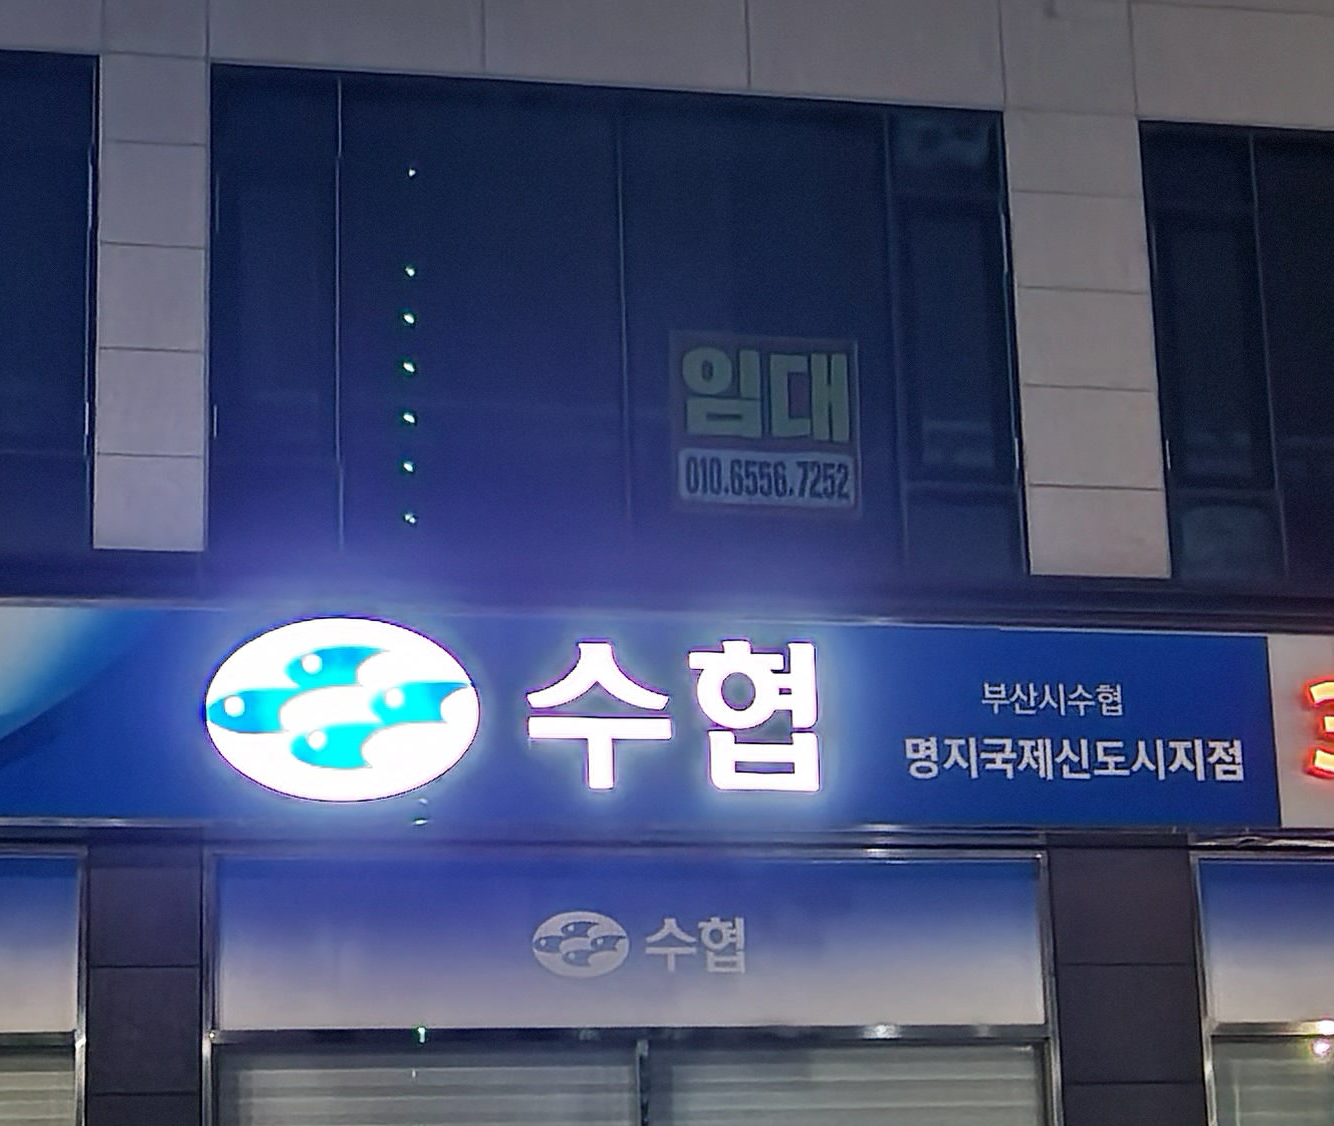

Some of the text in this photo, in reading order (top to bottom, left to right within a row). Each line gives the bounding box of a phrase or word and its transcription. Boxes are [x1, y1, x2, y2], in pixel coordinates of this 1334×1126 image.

[682, 347, 850, 443] 임대
[685, 455, 851, 501] 010.6556.7252
[525, 638, 822, 793] 수협
[980, 681, 1124, 718] 부산시수협
[904, 736, 1246, 783] 명지국제신도시지점
[643, 916, 748, 976] 수협
